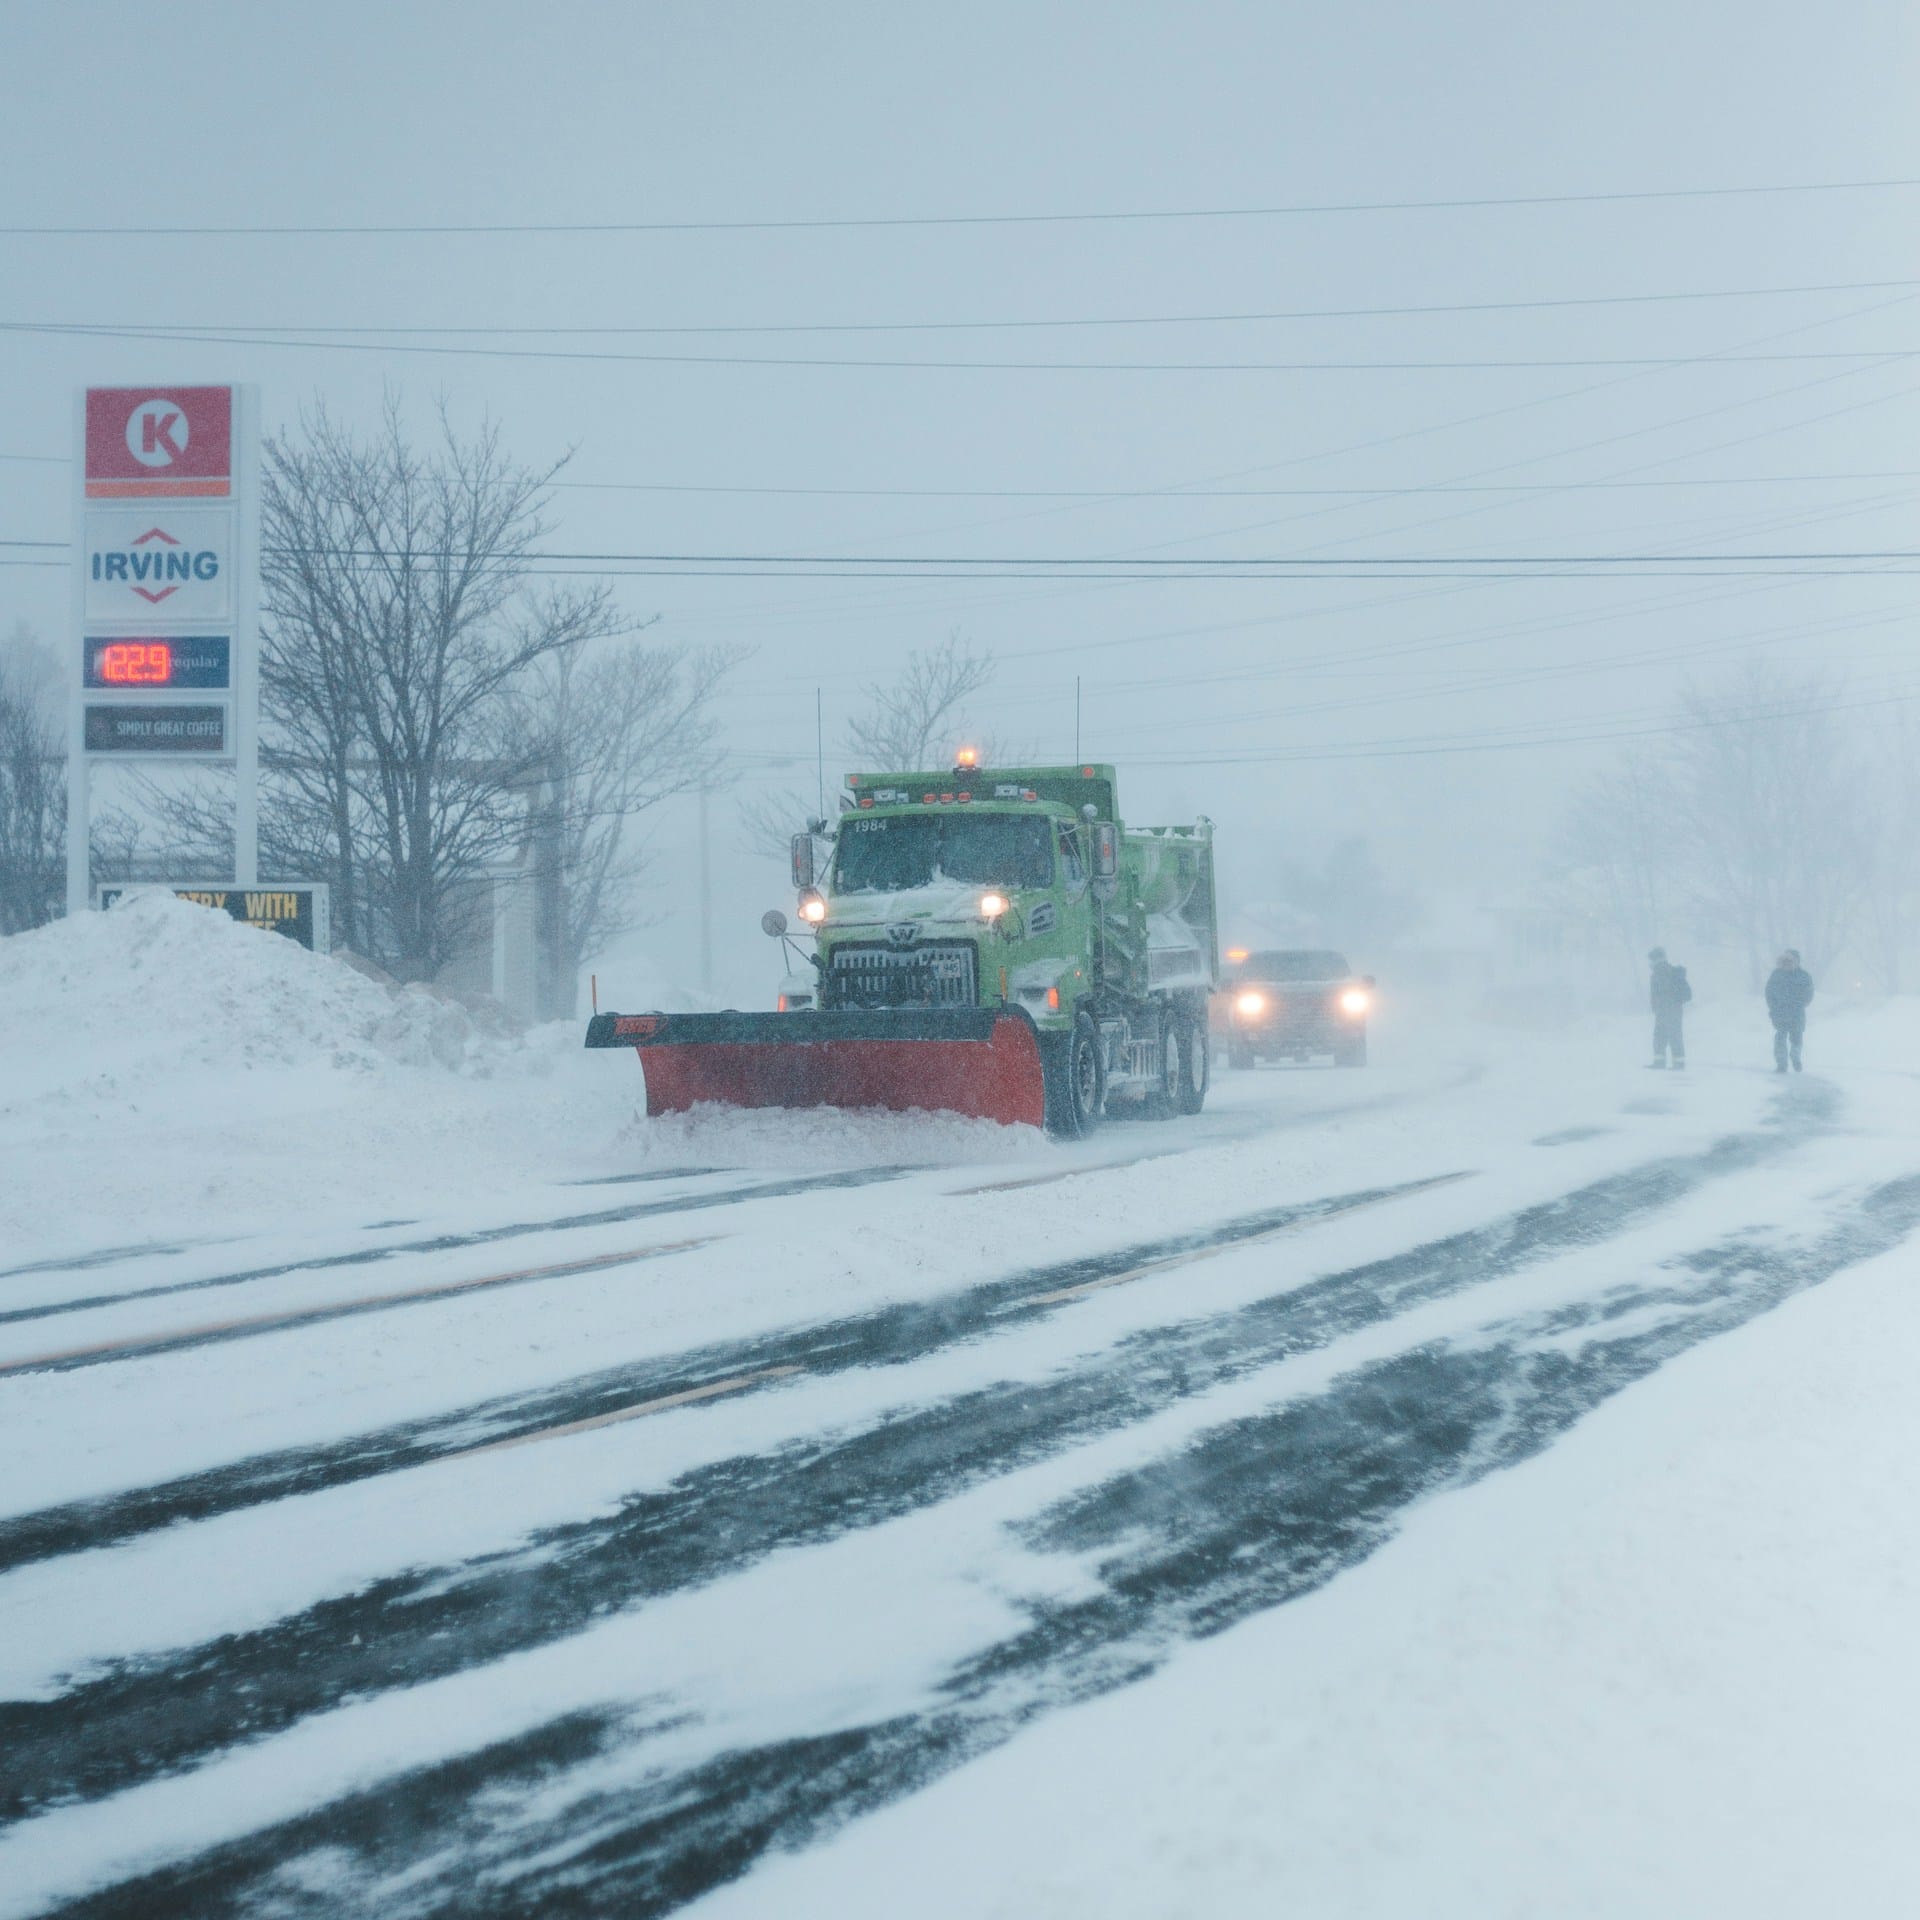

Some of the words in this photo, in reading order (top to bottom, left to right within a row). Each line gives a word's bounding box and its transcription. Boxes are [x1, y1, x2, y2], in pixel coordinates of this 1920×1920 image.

[143, 413, 184, 457] K
[92, 552, 219, 581] IRVING
[117, 721, 150, 736] SIMPLY
[153, 721, 184, 736] GREAT
[187, 720, 221, 736] COFFEE
[855, 819, 887, 833] 1984
[245, 892, 297, 919] WITH
